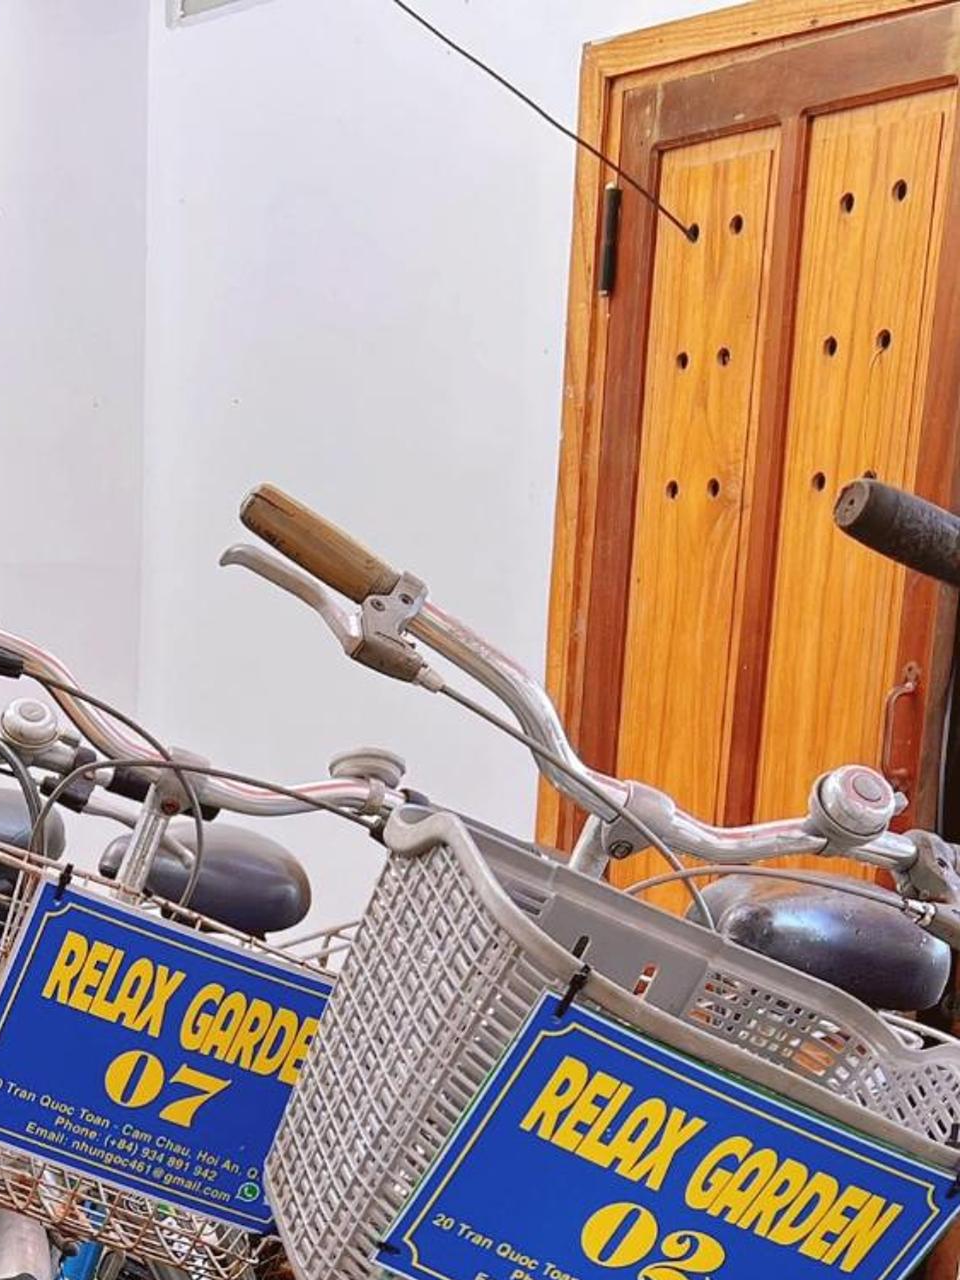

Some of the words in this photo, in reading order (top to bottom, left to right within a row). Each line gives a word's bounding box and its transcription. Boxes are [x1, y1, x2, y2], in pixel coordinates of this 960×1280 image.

[41, 929, 187, 1038] RELAX
[180, 982, 321, 1087] GARDE
[6, 1081, 37, 1102] Tran
[39, 1094, 75, 1116] Quoc
[78, 1107, 111, 1129] Toan
[121, 1123, 153, 1143] Cam
[196, 1149, 219, 1167] Hoi
[103, 1049, 232, 1129] 07
[25, 1121, 69, 1147] Email:
[71, 1139, 231, 1203] nhungoc461@gmail.com
[54, 1114, 100, 1142] Phone:
[103, 1133, 139, 1157] (+84)
[141, 1147, 164, 1163] 934
[166, 1156, 190, 1173] 891
[193, 1165, 218, 1182] 942
[519, 1055, 706, 1194] RELAX
[684, 1134, 905, 1274] GARDEN
[431, 1212, 455, 1231] 20
[457, 1222, 494, 1250] Tran
[495, 1242, 540, 1271] Quoc
